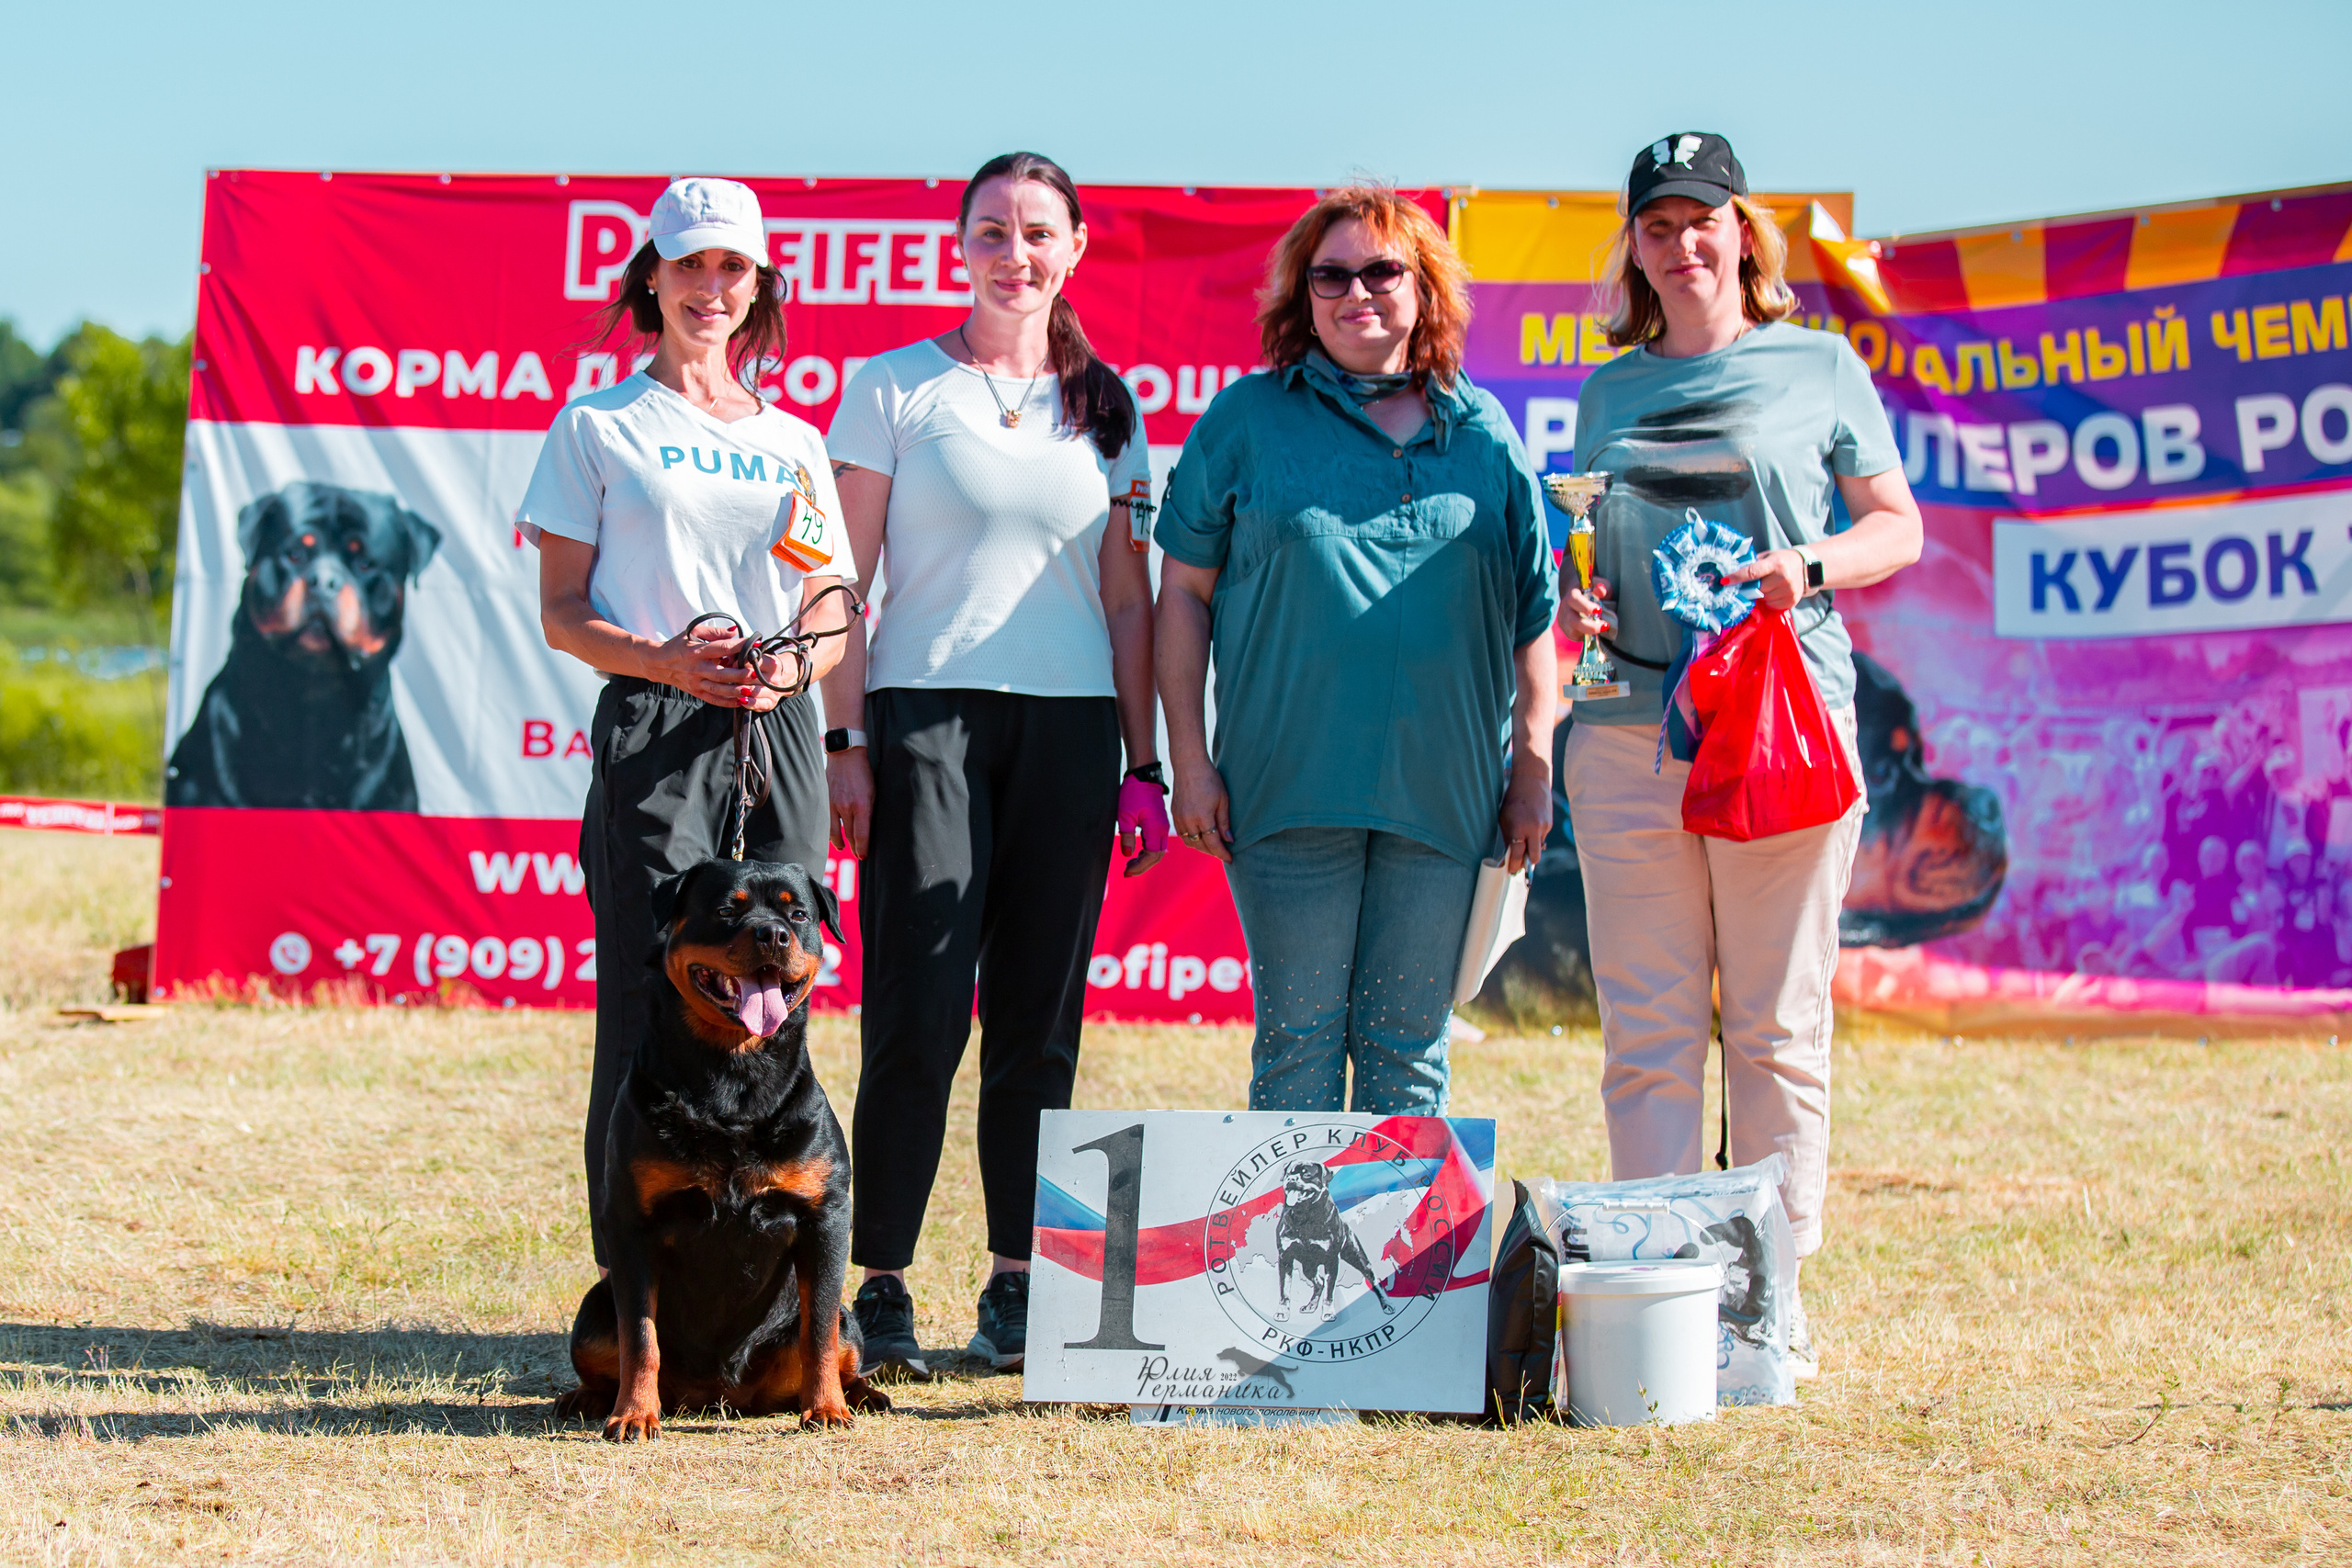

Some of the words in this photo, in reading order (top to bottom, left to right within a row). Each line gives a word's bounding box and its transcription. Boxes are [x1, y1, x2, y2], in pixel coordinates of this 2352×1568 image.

[2211, 292, 2352, 362] ЧЕМ
[294, 345, 554, 400] КОРМА
[659, 446, 803, 491] PUMA
[2029, 526, 2319, 614] КУБОК
[334, 933, 401, 976] +7
[413, 933, 565, 991] (909)
[1087, 942, 1252, 1001] ofipe
[1064, 1123, 1166, 1350] 1
[1208, 1132, 1308, 1296] РОТВЕЙЛЕР
[1327, 1128, 1410, 1168] КЛУБ
[1413, 1173, 1452, 1303] РОССИИ
[1261, 1324, 1396, 1359] РКФ-НКПР
